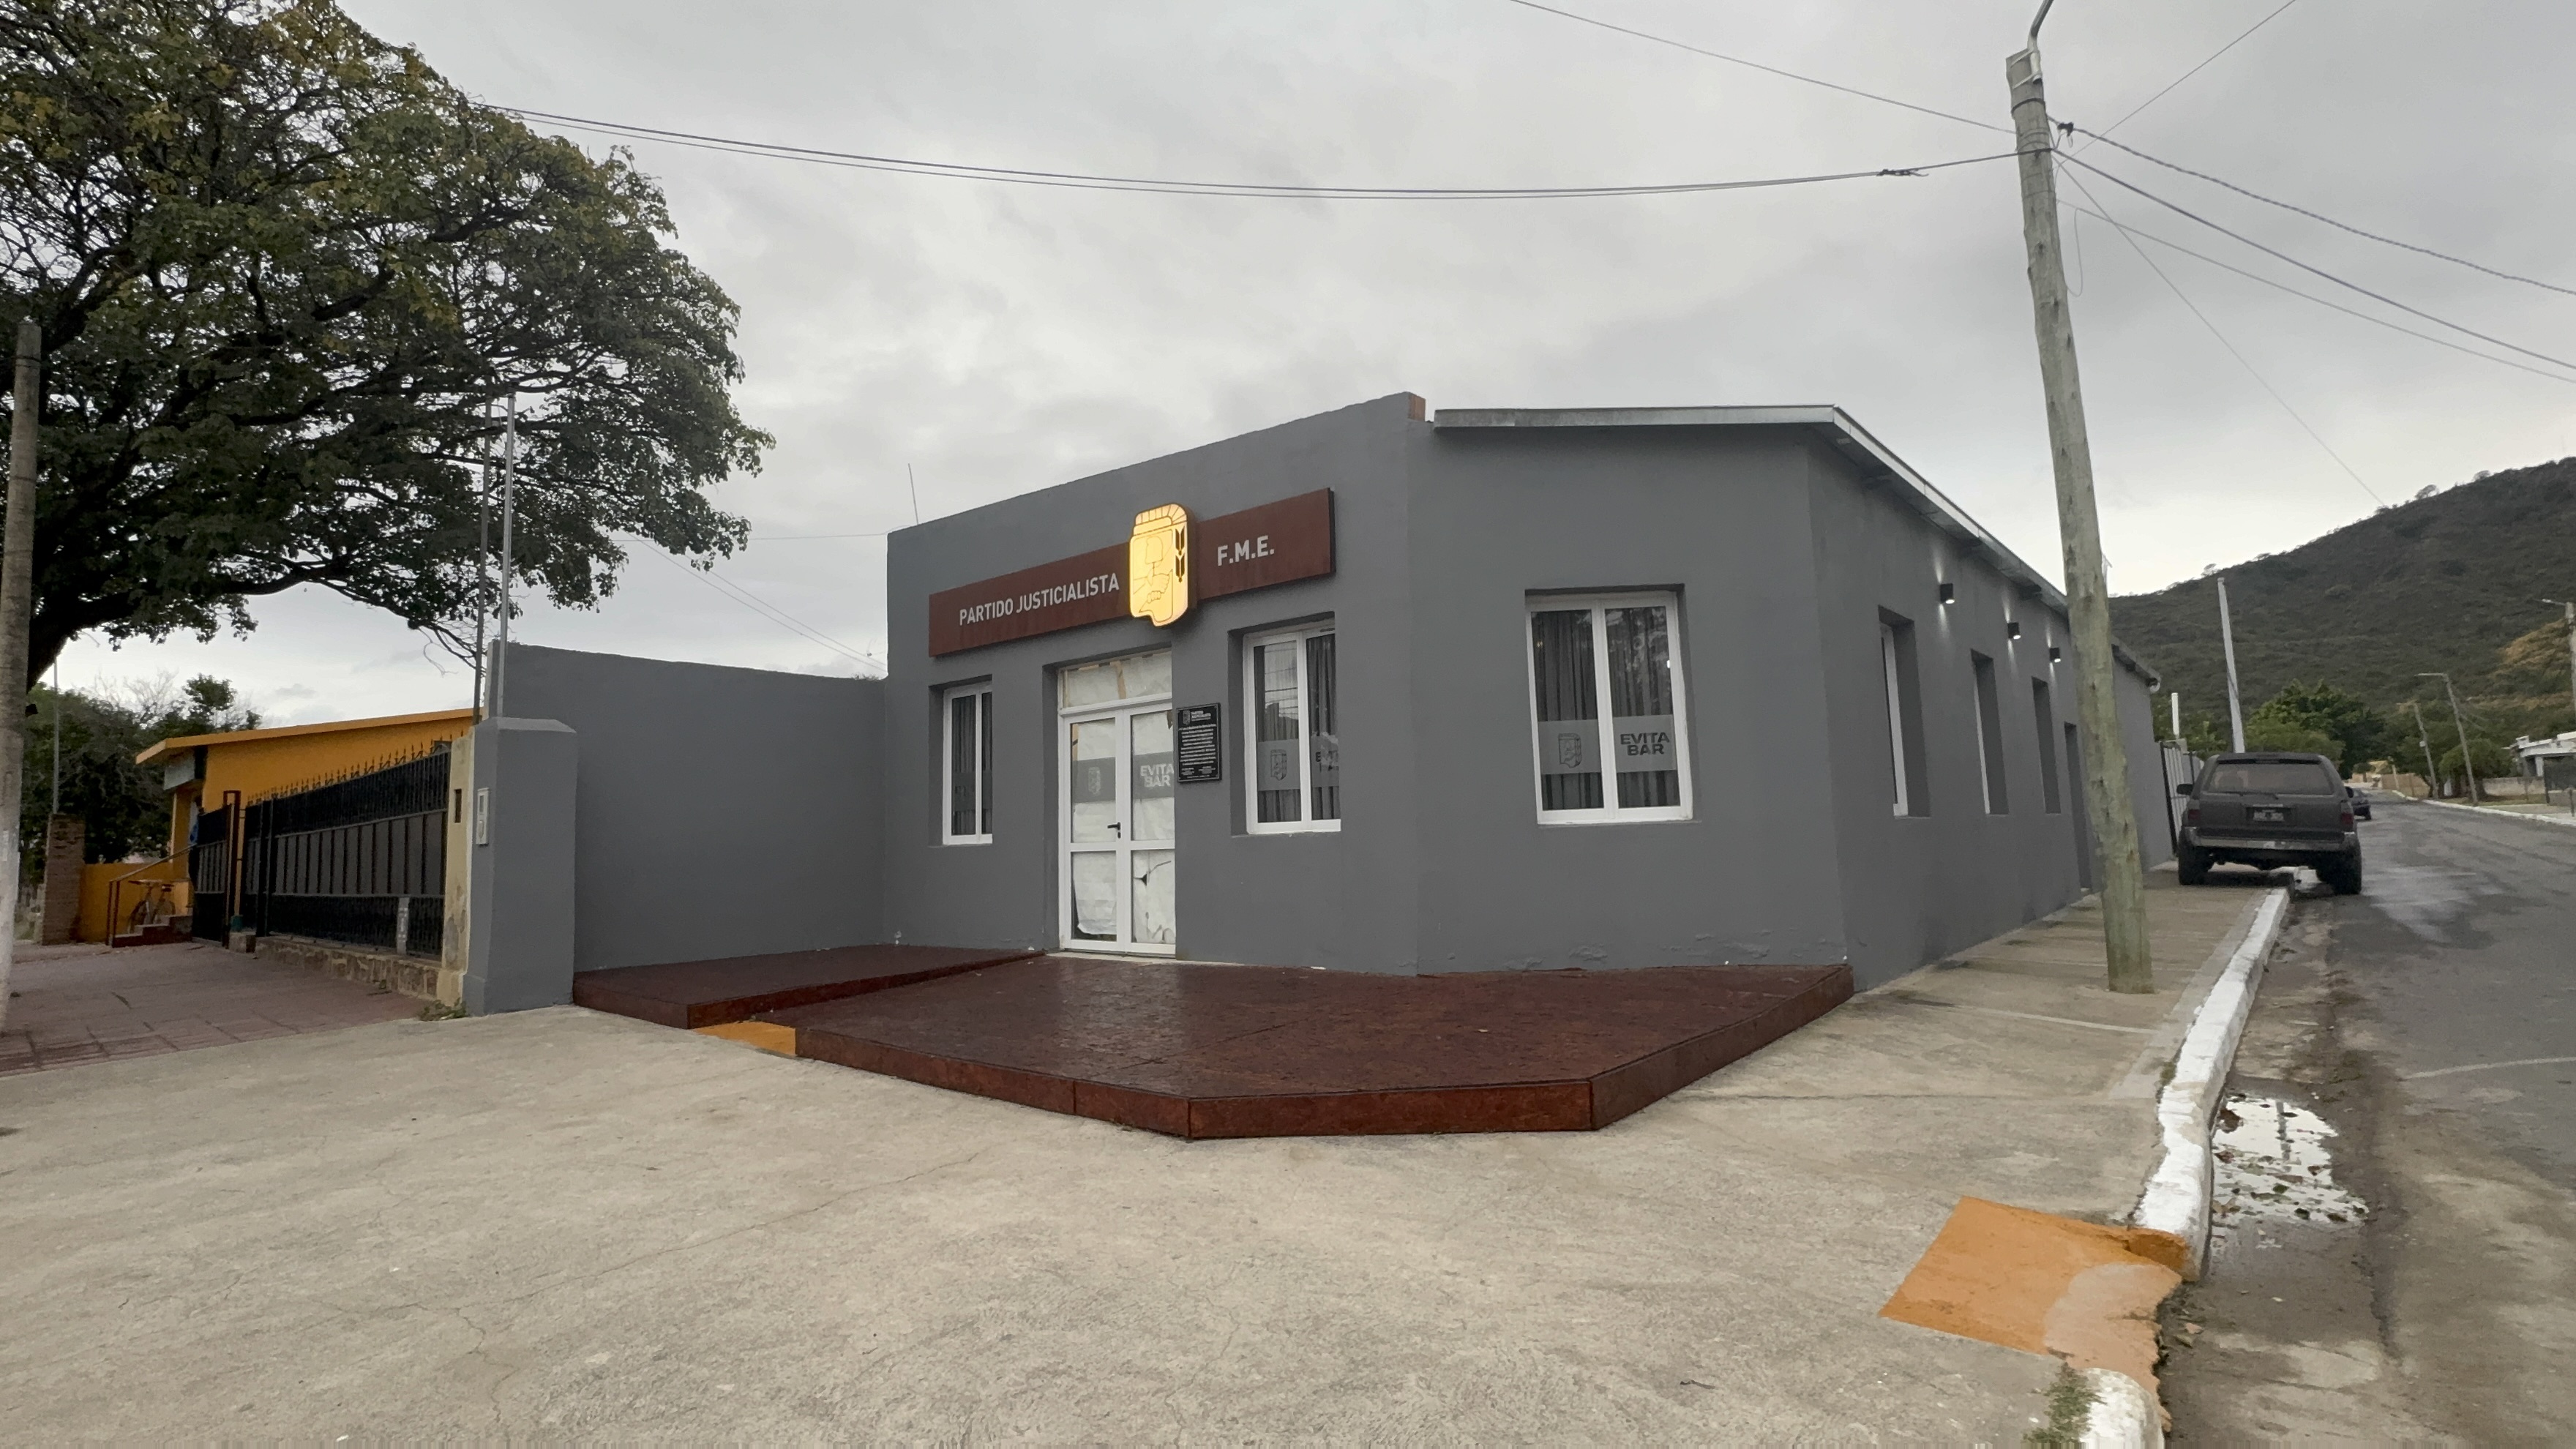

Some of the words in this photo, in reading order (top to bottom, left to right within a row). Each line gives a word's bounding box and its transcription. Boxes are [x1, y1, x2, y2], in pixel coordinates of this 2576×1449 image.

[1217, 535, 1275, 566] F.M.E.
[959, 598, 1014, 626] PARTIDO
[1016, 572, 1120, 614] JUSTICIALISTA
[1620, 732, 1670, 745] EVITA
[1627, 744, 1665, 756] BAR
[1140, 763, 1175, 776] EVITA
[1144, 774, 1171, 787] BAR
